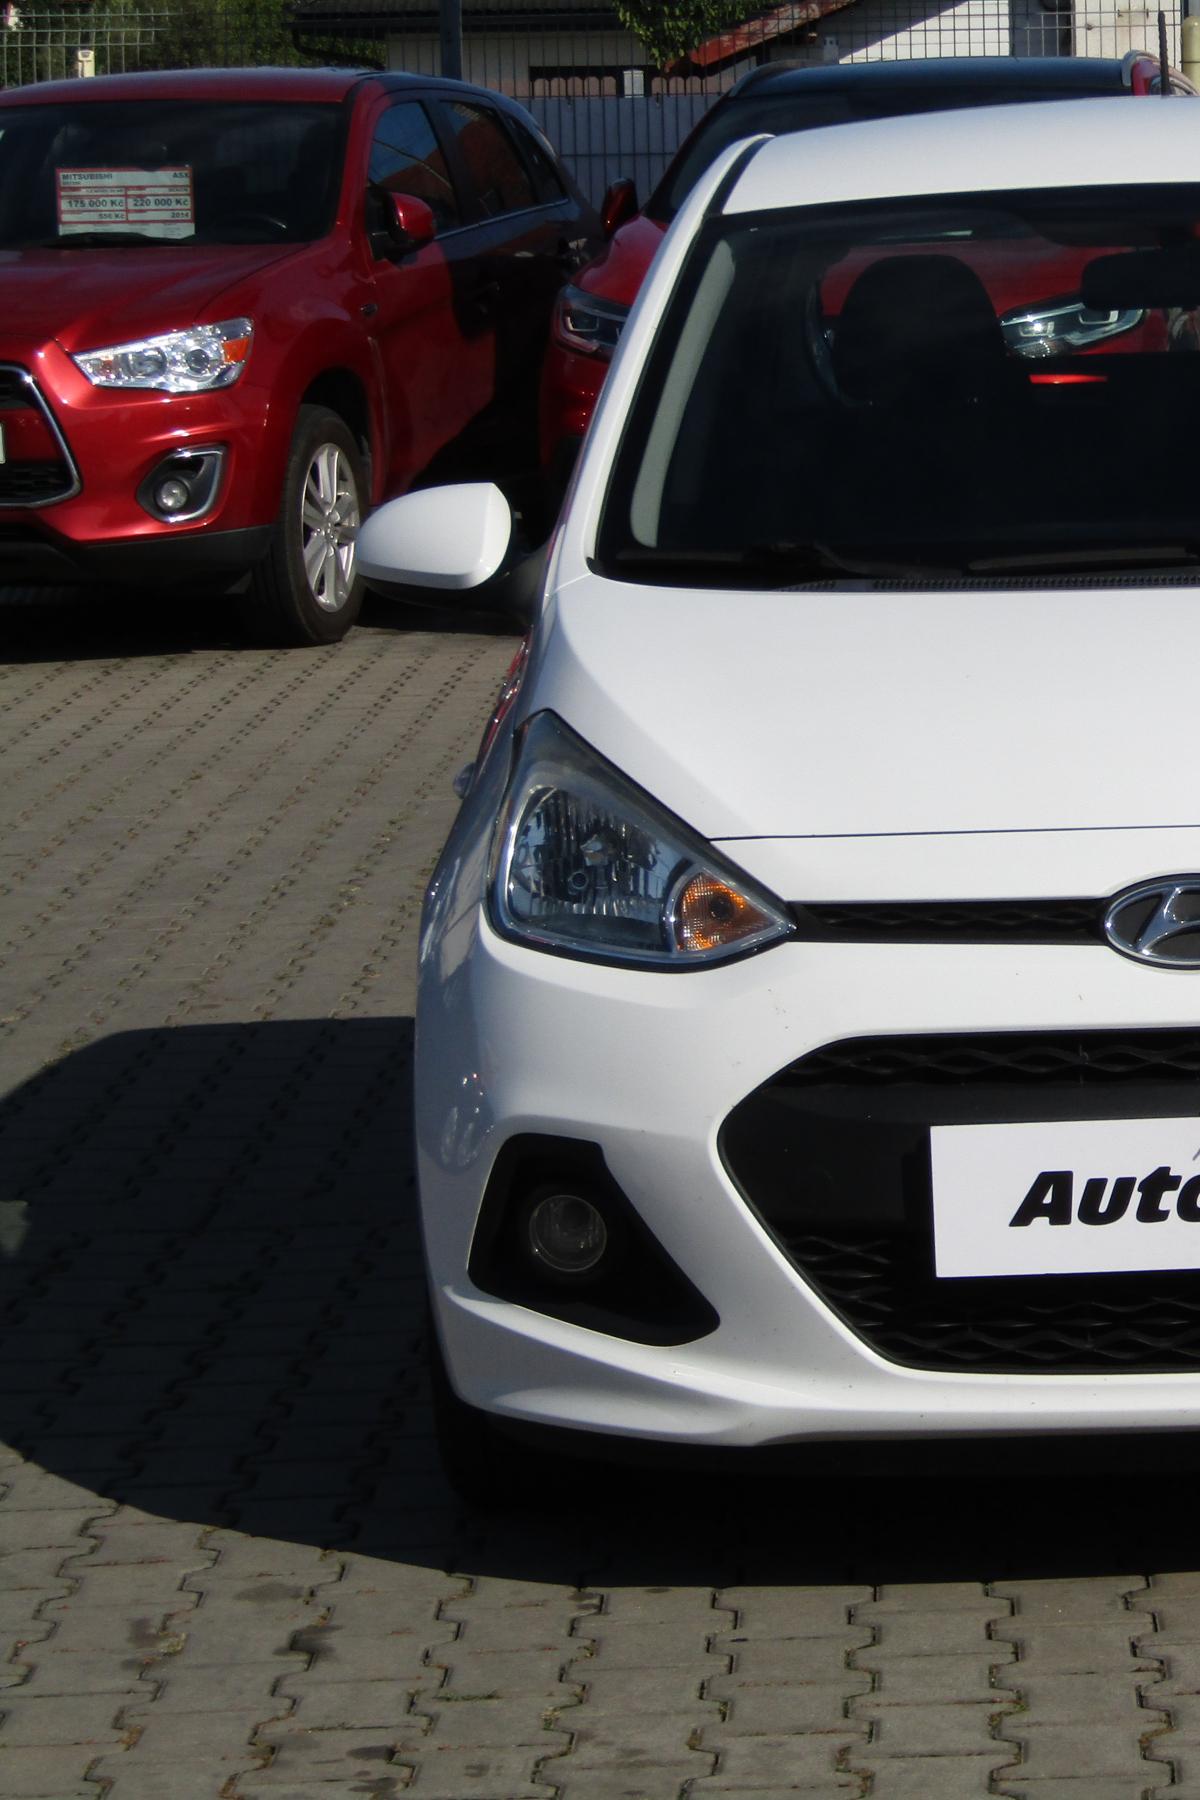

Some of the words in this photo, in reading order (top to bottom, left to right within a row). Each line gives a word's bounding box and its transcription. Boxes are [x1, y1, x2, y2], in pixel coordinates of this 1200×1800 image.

[68, 199, 86, 207] 175
[88, 199, 107, 207] 000
[133, 198, 151, 207] 220
[154, 198, 173, 206] 000
